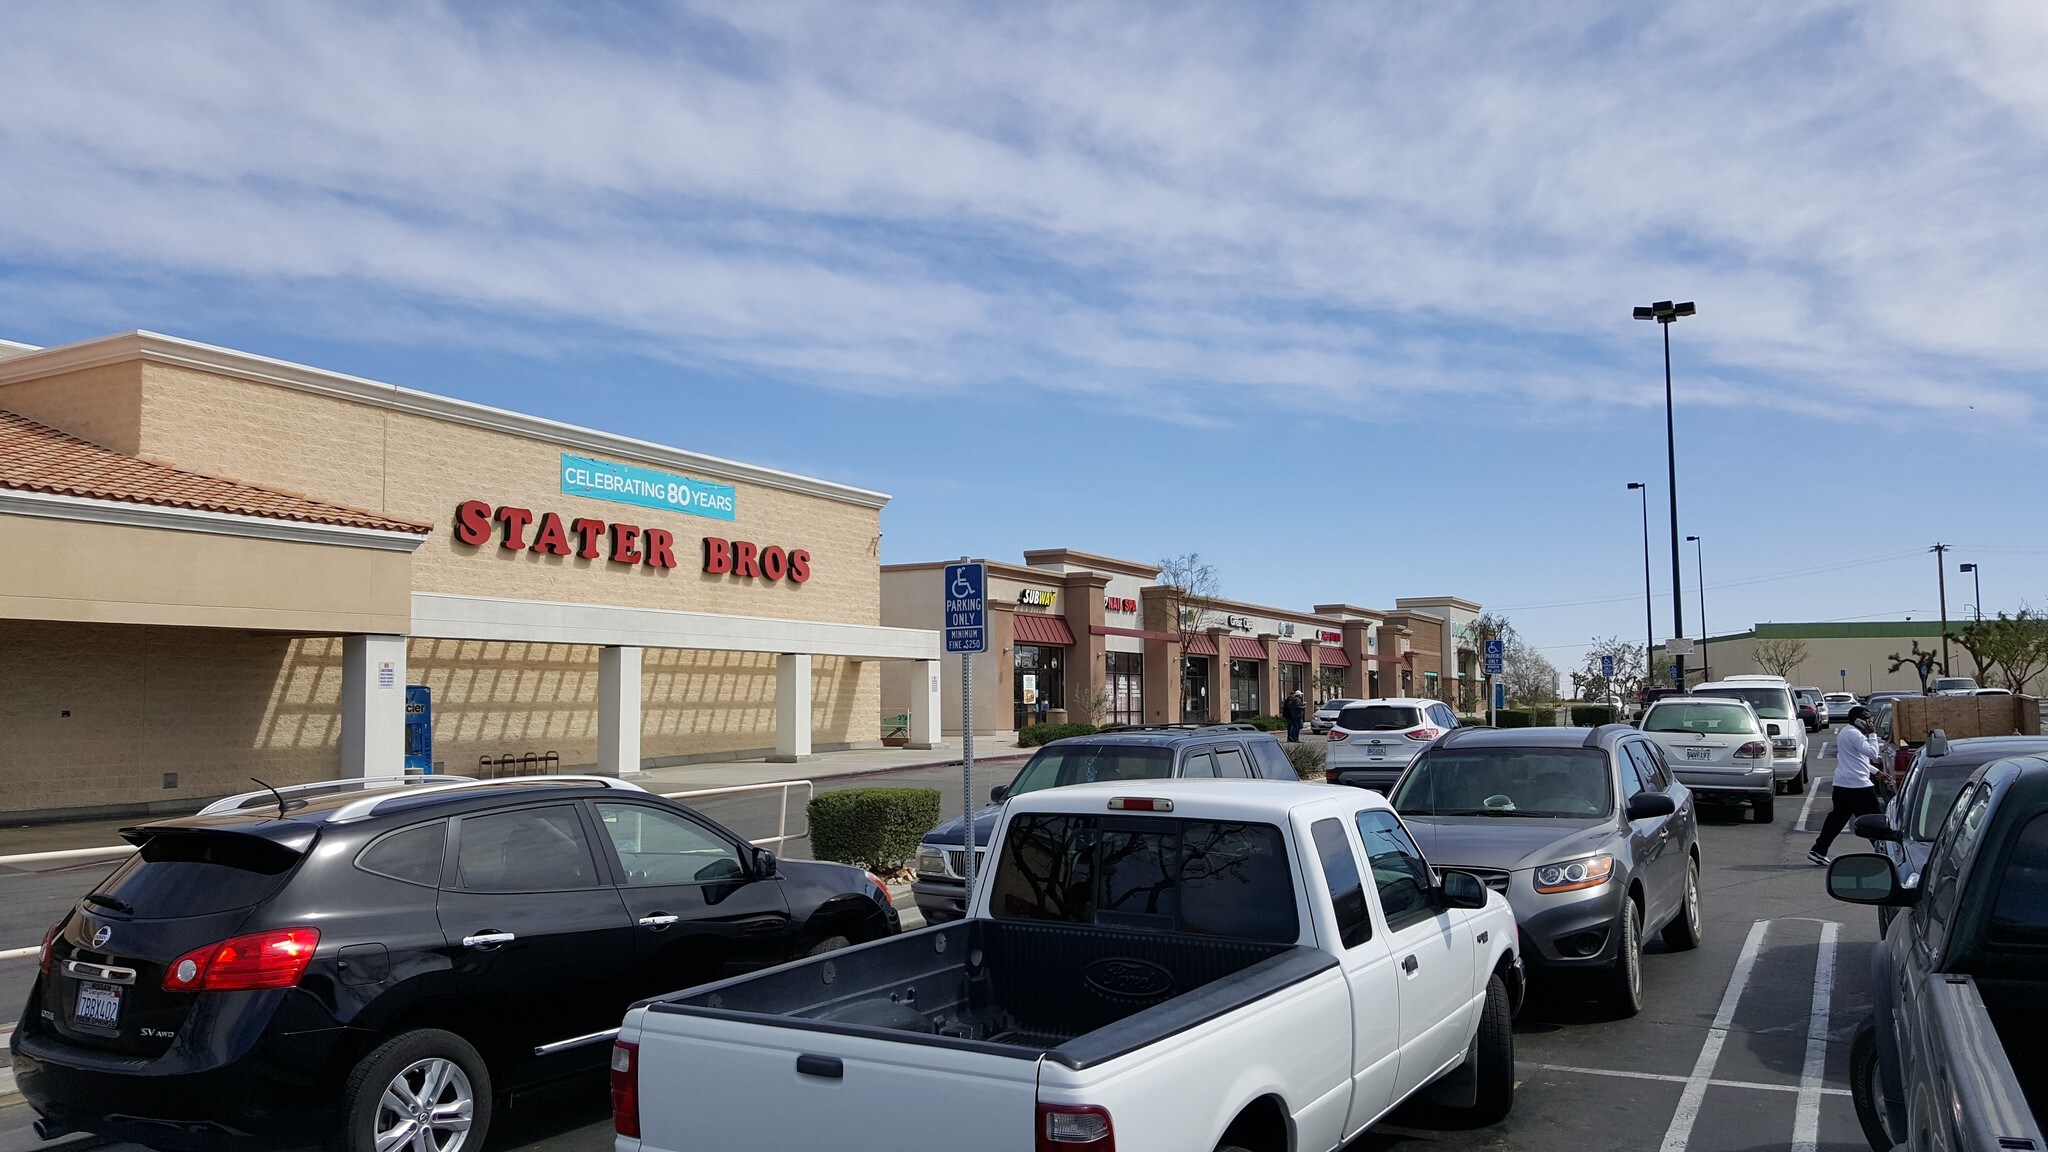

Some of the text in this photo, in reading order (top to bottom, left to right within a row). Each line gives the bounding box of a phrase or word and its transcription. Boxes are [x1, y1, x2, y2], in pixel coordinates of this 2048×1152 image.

[565, 467, 732, 512] CELEBRATING 80 YEARS
[454, 500, 810, 583] STATER BROS
[1022, 589, 1056, 606] SUBWAY
[1108, 597, 1122, 612] NAIL
[1123, 598, 1137, 612] SPA
[946, 598, 981, 612] PARKING
[952, 613, 975, 626] ONLY
[951, 629, 977, 639] MINIMUM
[949, 639, 980, 650] FINE $250
[406, 702, 425, 713] cier
[1103, 962, 1154, 990] Ford
[140, 1027, 156, 1036] SV
